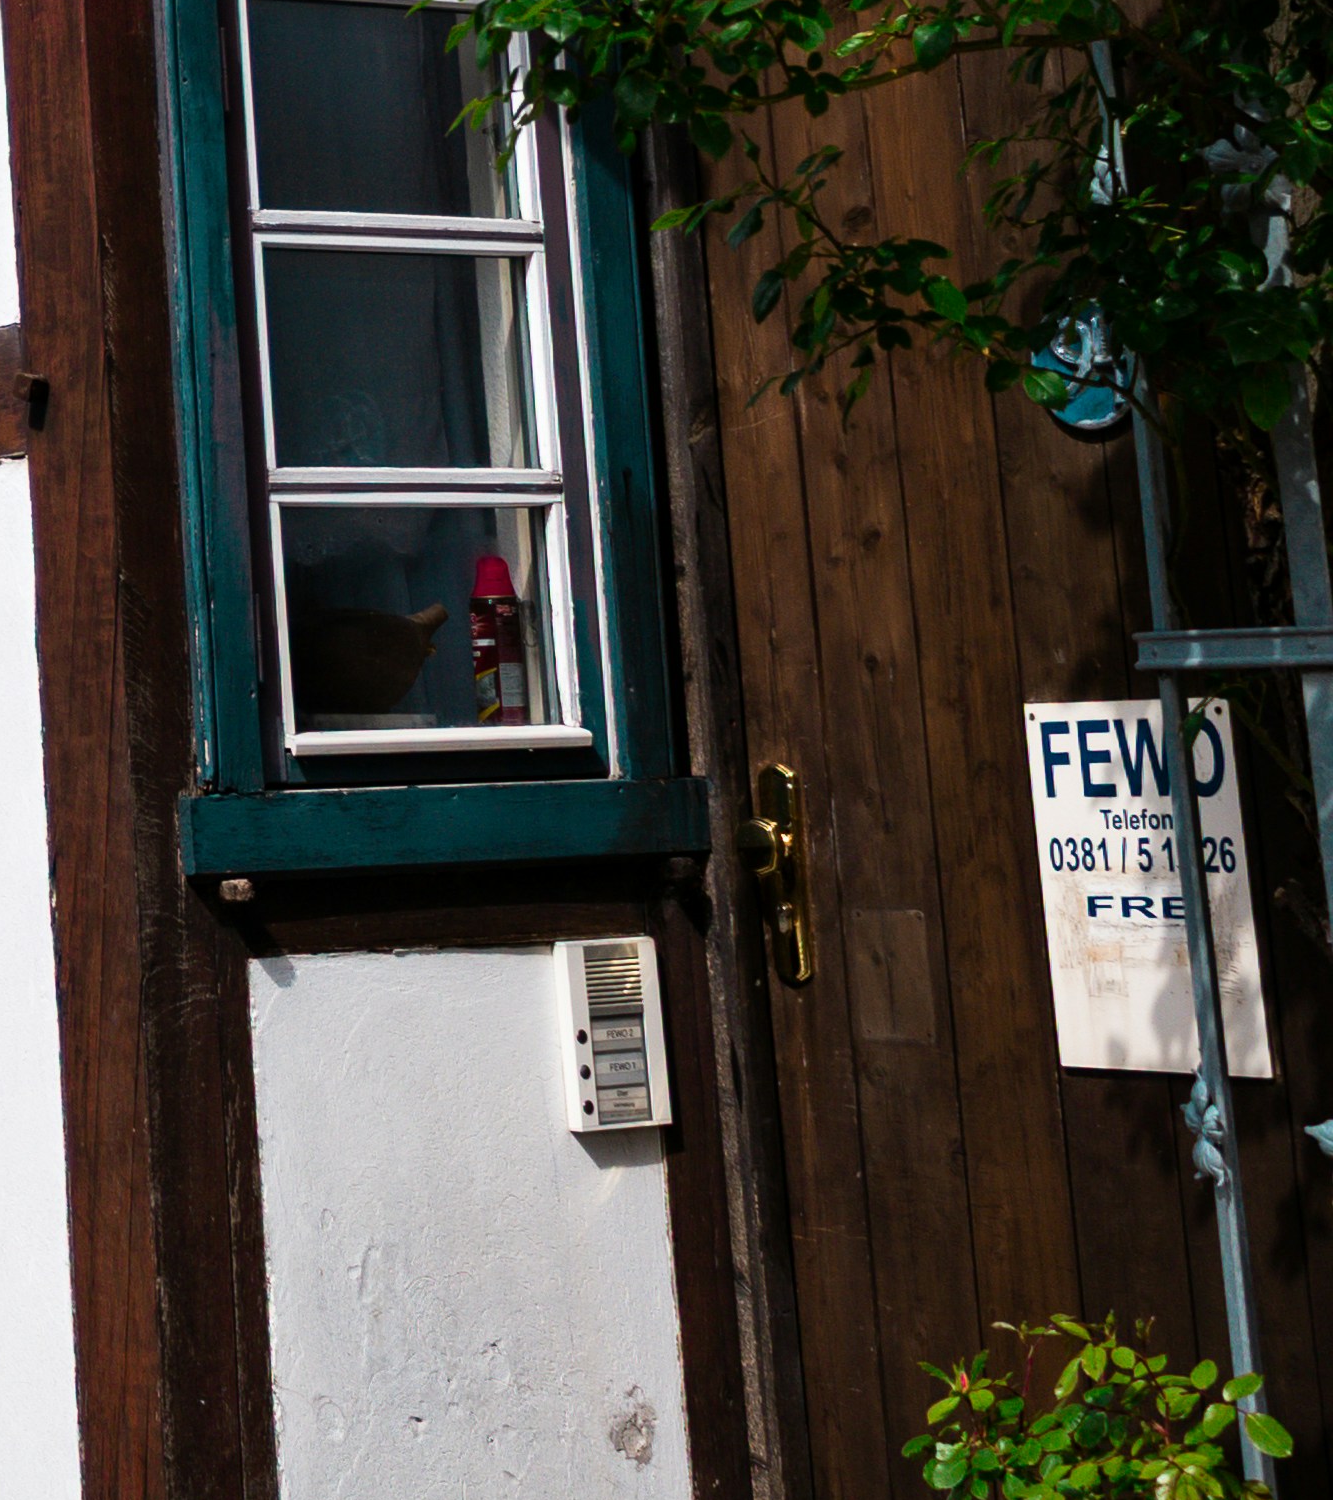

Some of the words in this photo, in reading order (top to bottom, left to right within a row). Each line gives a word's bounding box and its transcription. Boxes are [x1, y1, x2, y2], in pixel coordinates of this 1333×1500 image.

[1040, 717, 1226, 798] FEWO
[1099, 808, 1174, 831] Telefon
[1049, 837, 1111, 872] 0381
[606, 1029, 628, 1039] FEWO
[609, 1062, 631, 1072] FEWO
